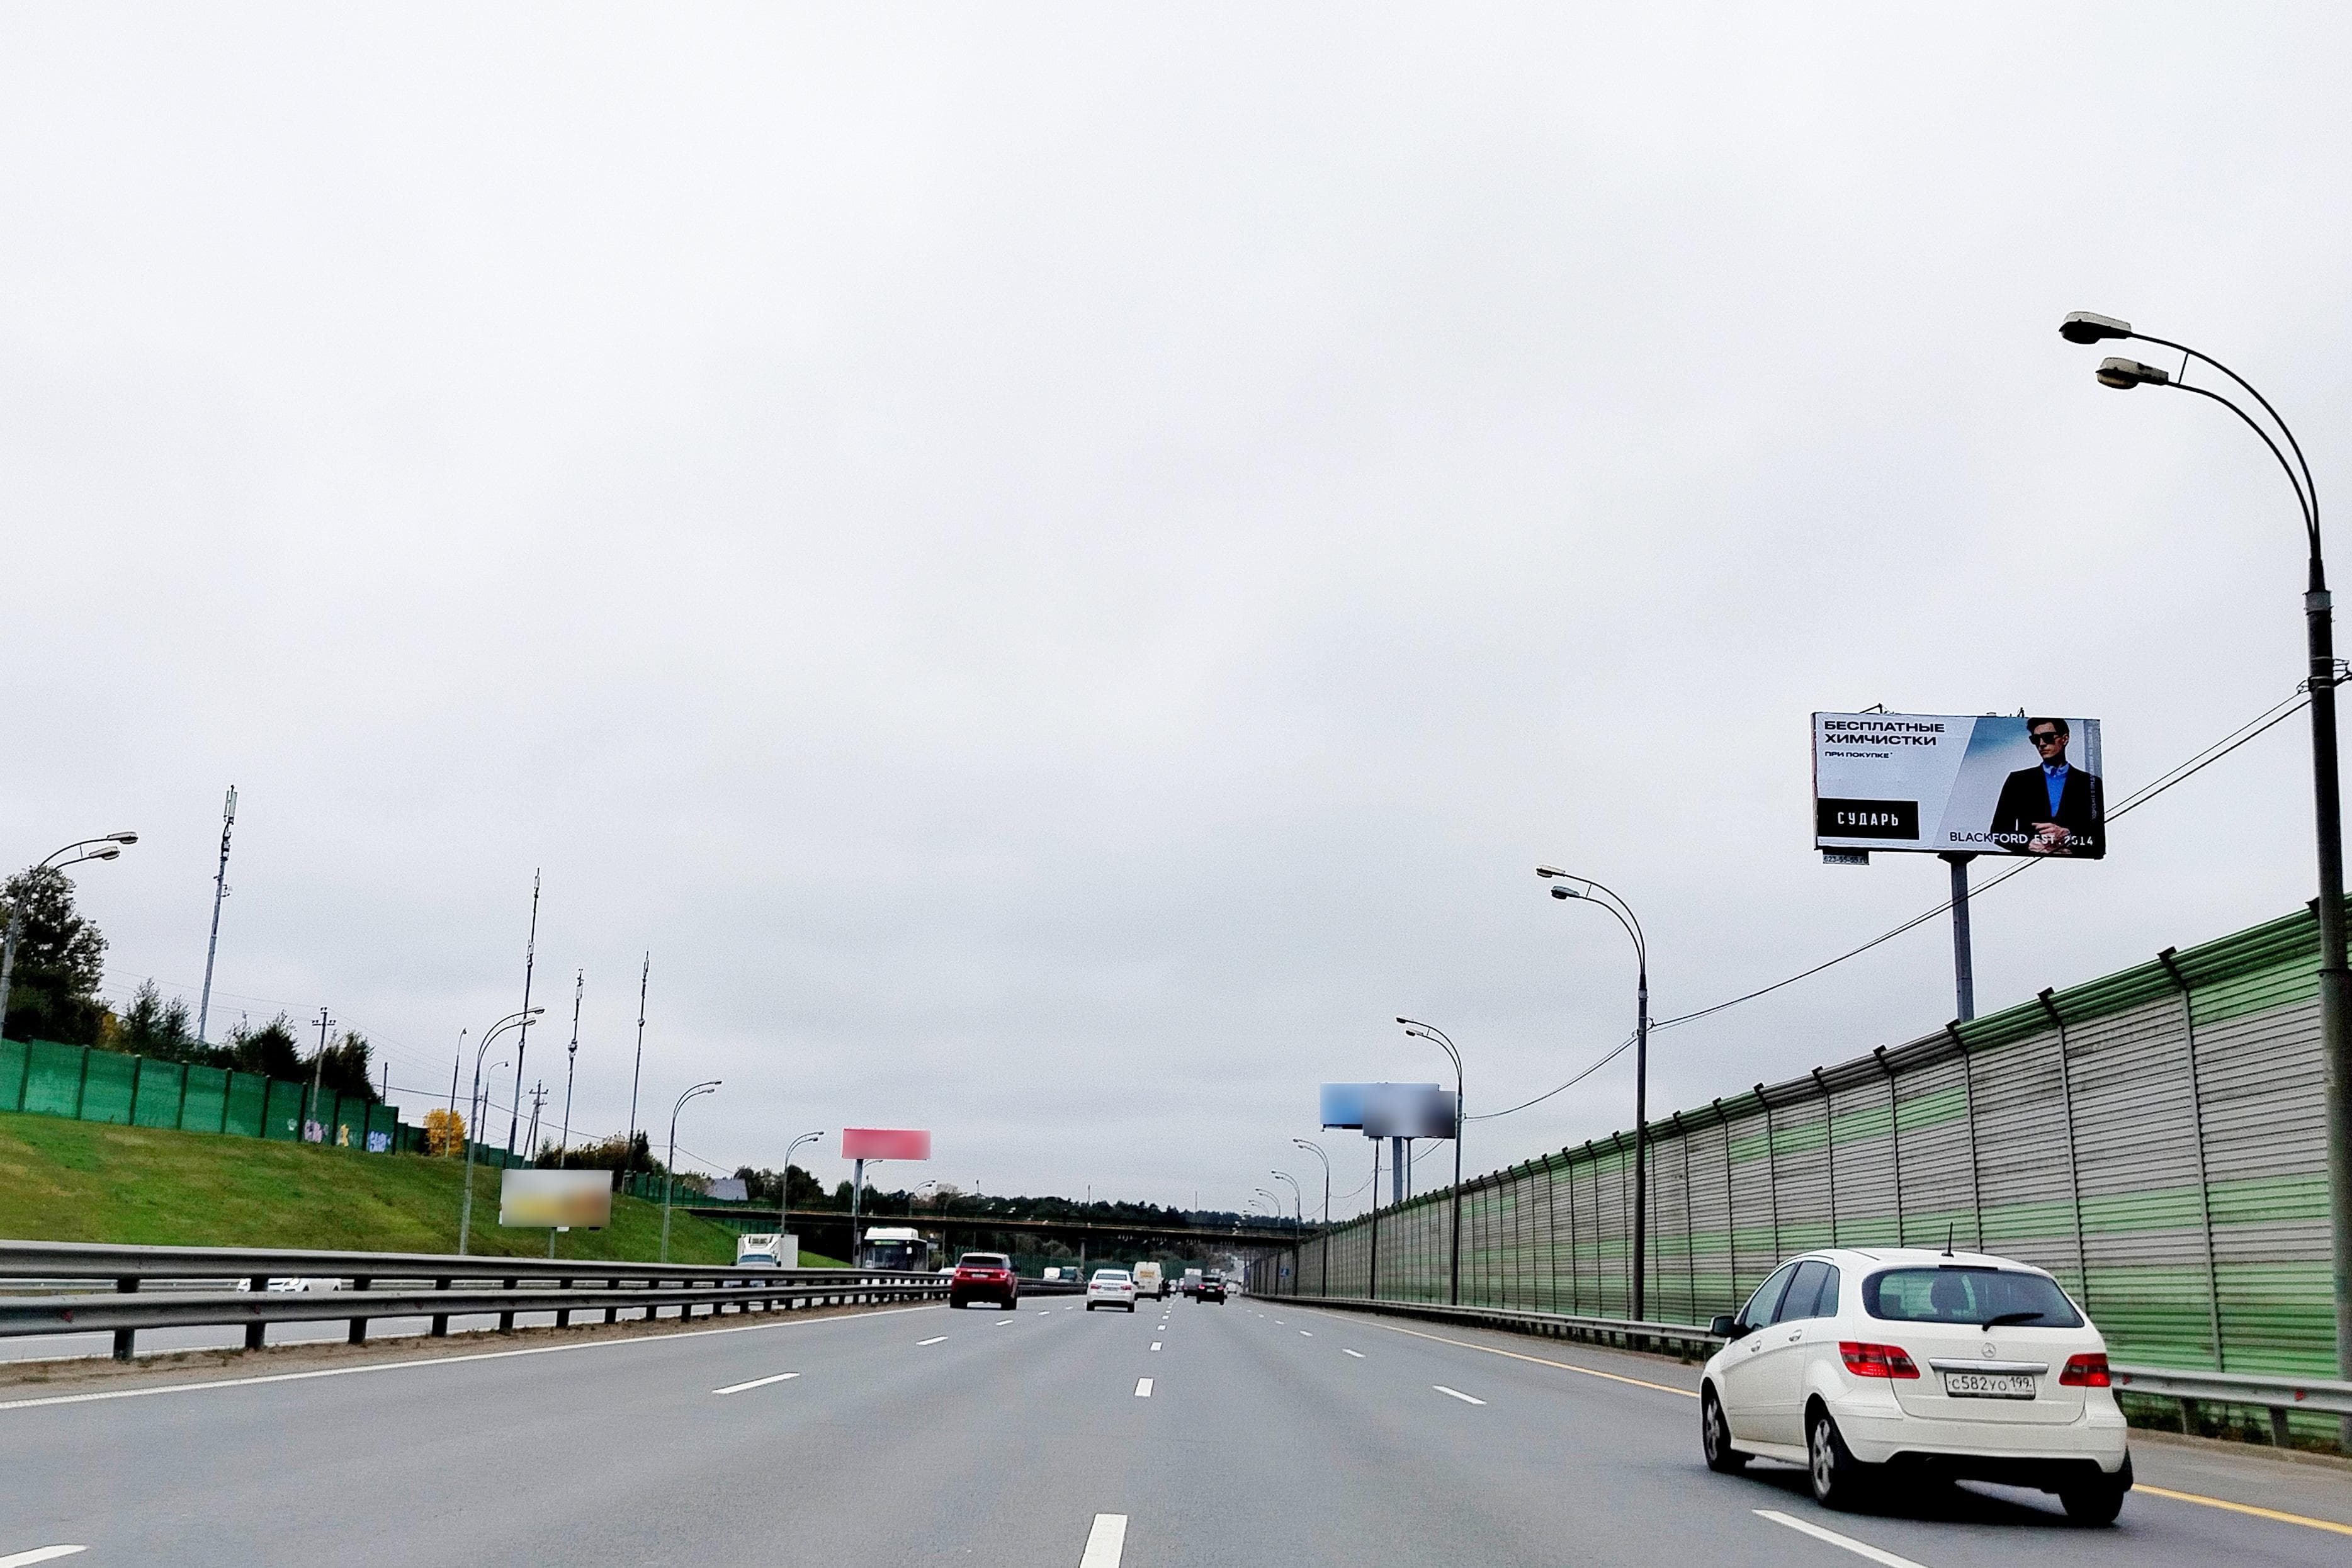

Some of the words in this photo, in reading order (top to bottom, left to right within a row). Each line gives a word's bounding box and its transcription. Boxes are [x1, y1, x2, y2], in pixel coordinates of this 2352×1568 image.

[1824, 721, 1945, 732] БЕСПЛАТНЫЕ
[1825, 734, 1936, 745] ХИМЧИСТКИ
[1838, 811, 1899, 826] СУДАРЬ
[1950, 832, 2028, 843] BLACKFORD
[2009, 1377, 2030, 1387] 199
